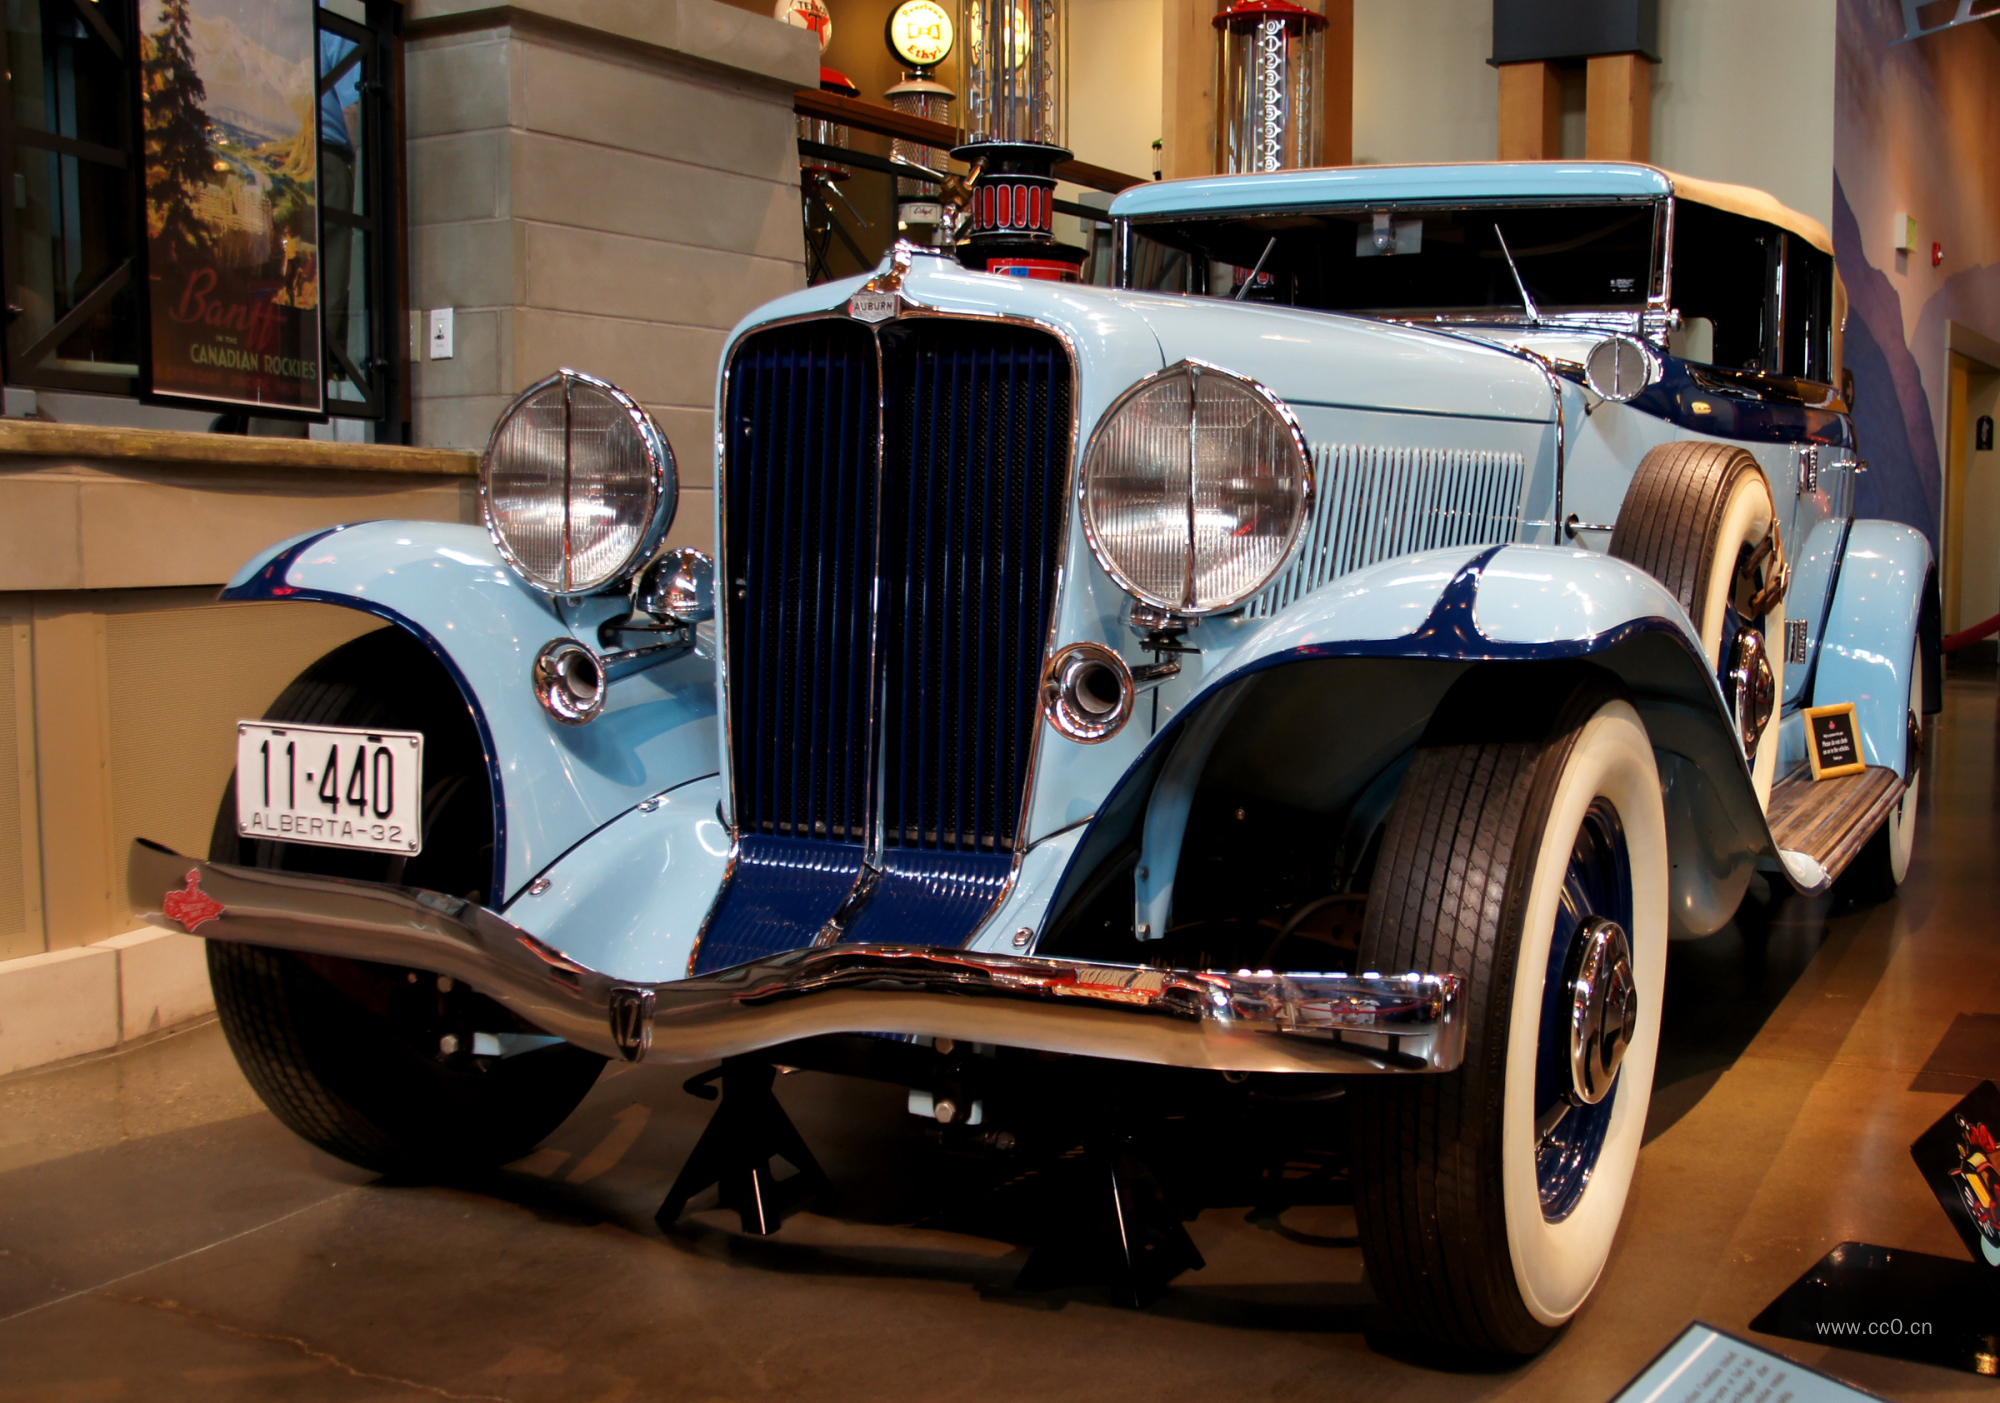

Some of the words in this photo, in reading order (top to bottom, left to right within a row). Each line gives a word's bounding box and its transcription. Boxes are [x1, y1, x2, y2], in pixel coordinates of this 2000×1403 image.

[906, 44, 942, 60] Ethyl
[169, 268, 288, 349] Banff
[854, 301, 893, 311] AUBURN
[190, 344, 259, 371] CANADIAN
[265, 355, 317, 380] ROCKIES
[252, 812, 402, 843] ALBERTA-32
